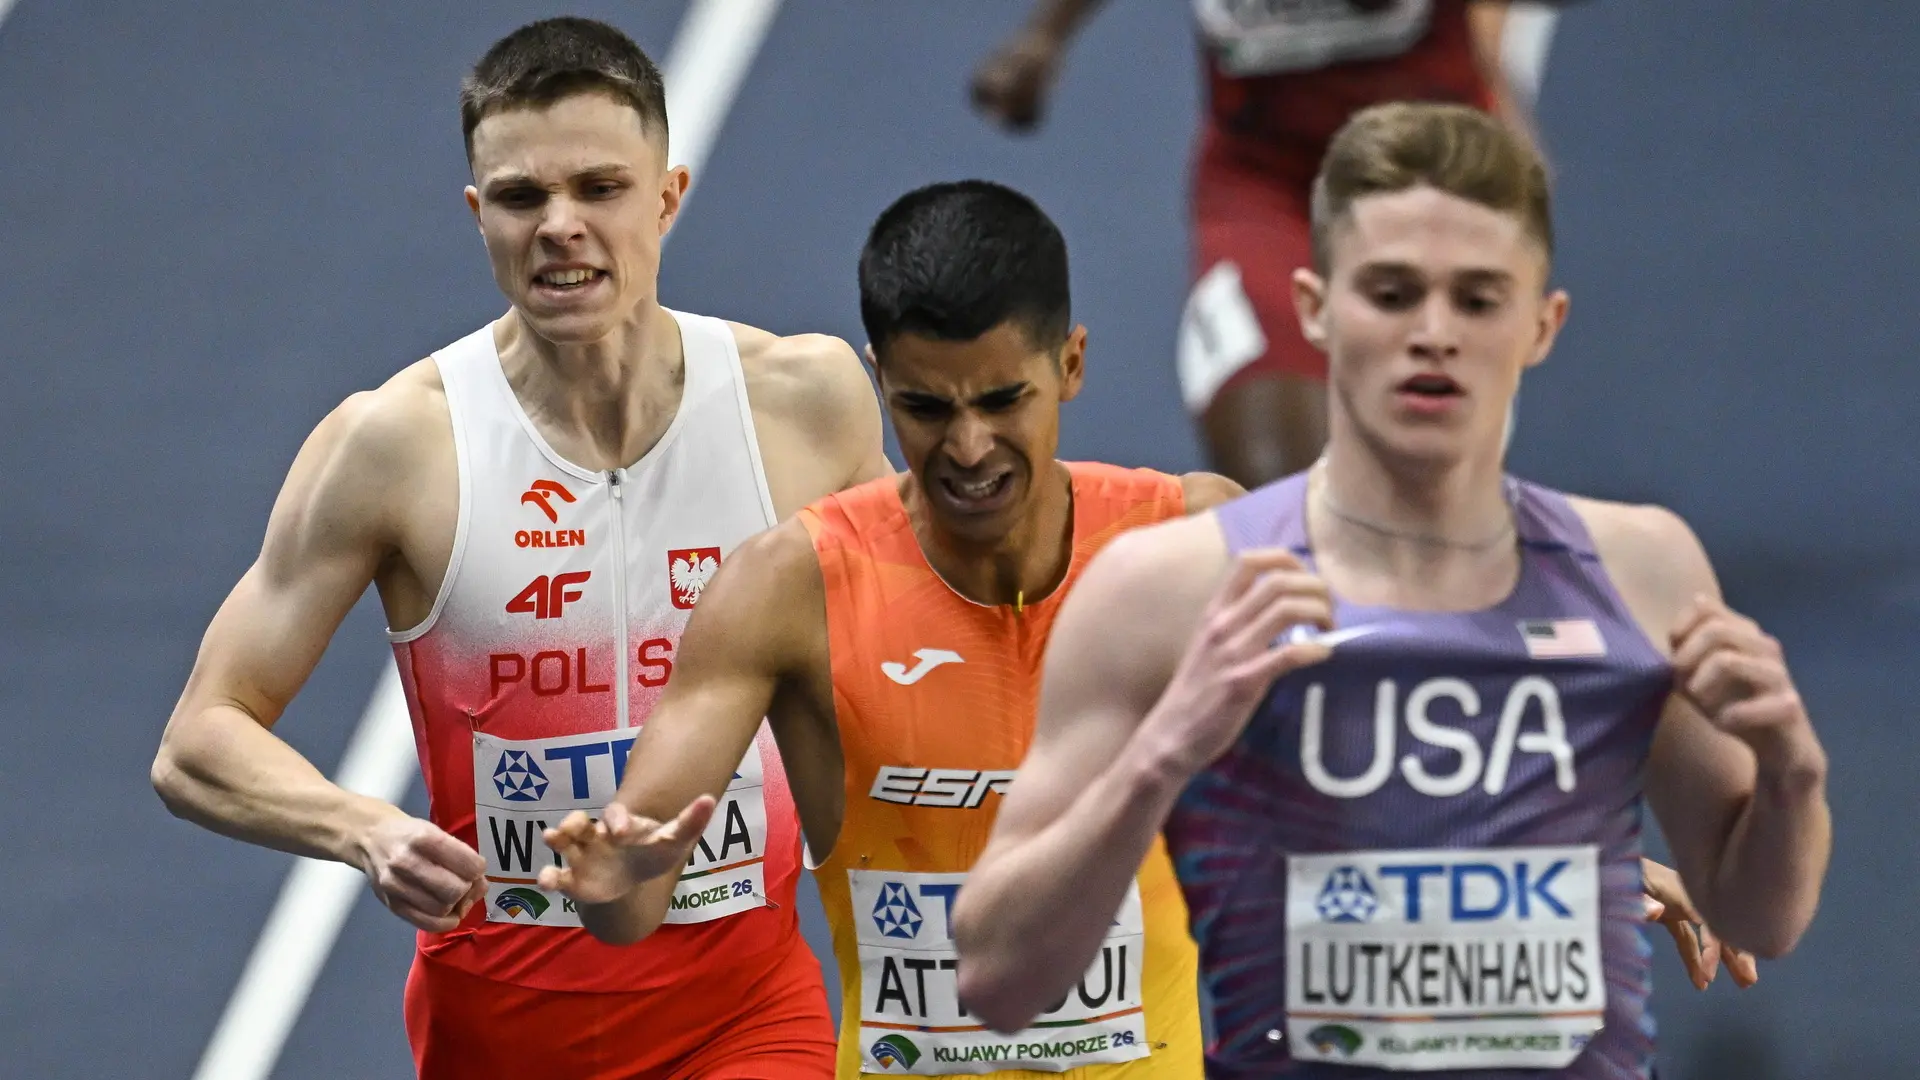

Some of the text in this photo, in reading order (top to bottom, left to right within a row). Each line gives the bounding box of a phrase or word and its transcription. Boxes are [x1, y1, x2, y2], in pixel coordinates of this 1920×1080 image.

[514, 529, 586, 548] ORLEN
[505, 570, 592, 619] 4F
[489, 637, 673, 698] POLS
[1302, 676, 1575, 798] USA
[868, 765, 1017, 809] ESP
[667, 879, 753, 910] MORZE 26
[1378, 860, 1572, 921] TDK
[1302, 940, 1589, 1006] LUTKENHAUS
[933, 1030, 1134, 1062] KUJAWY POMORZE 26
